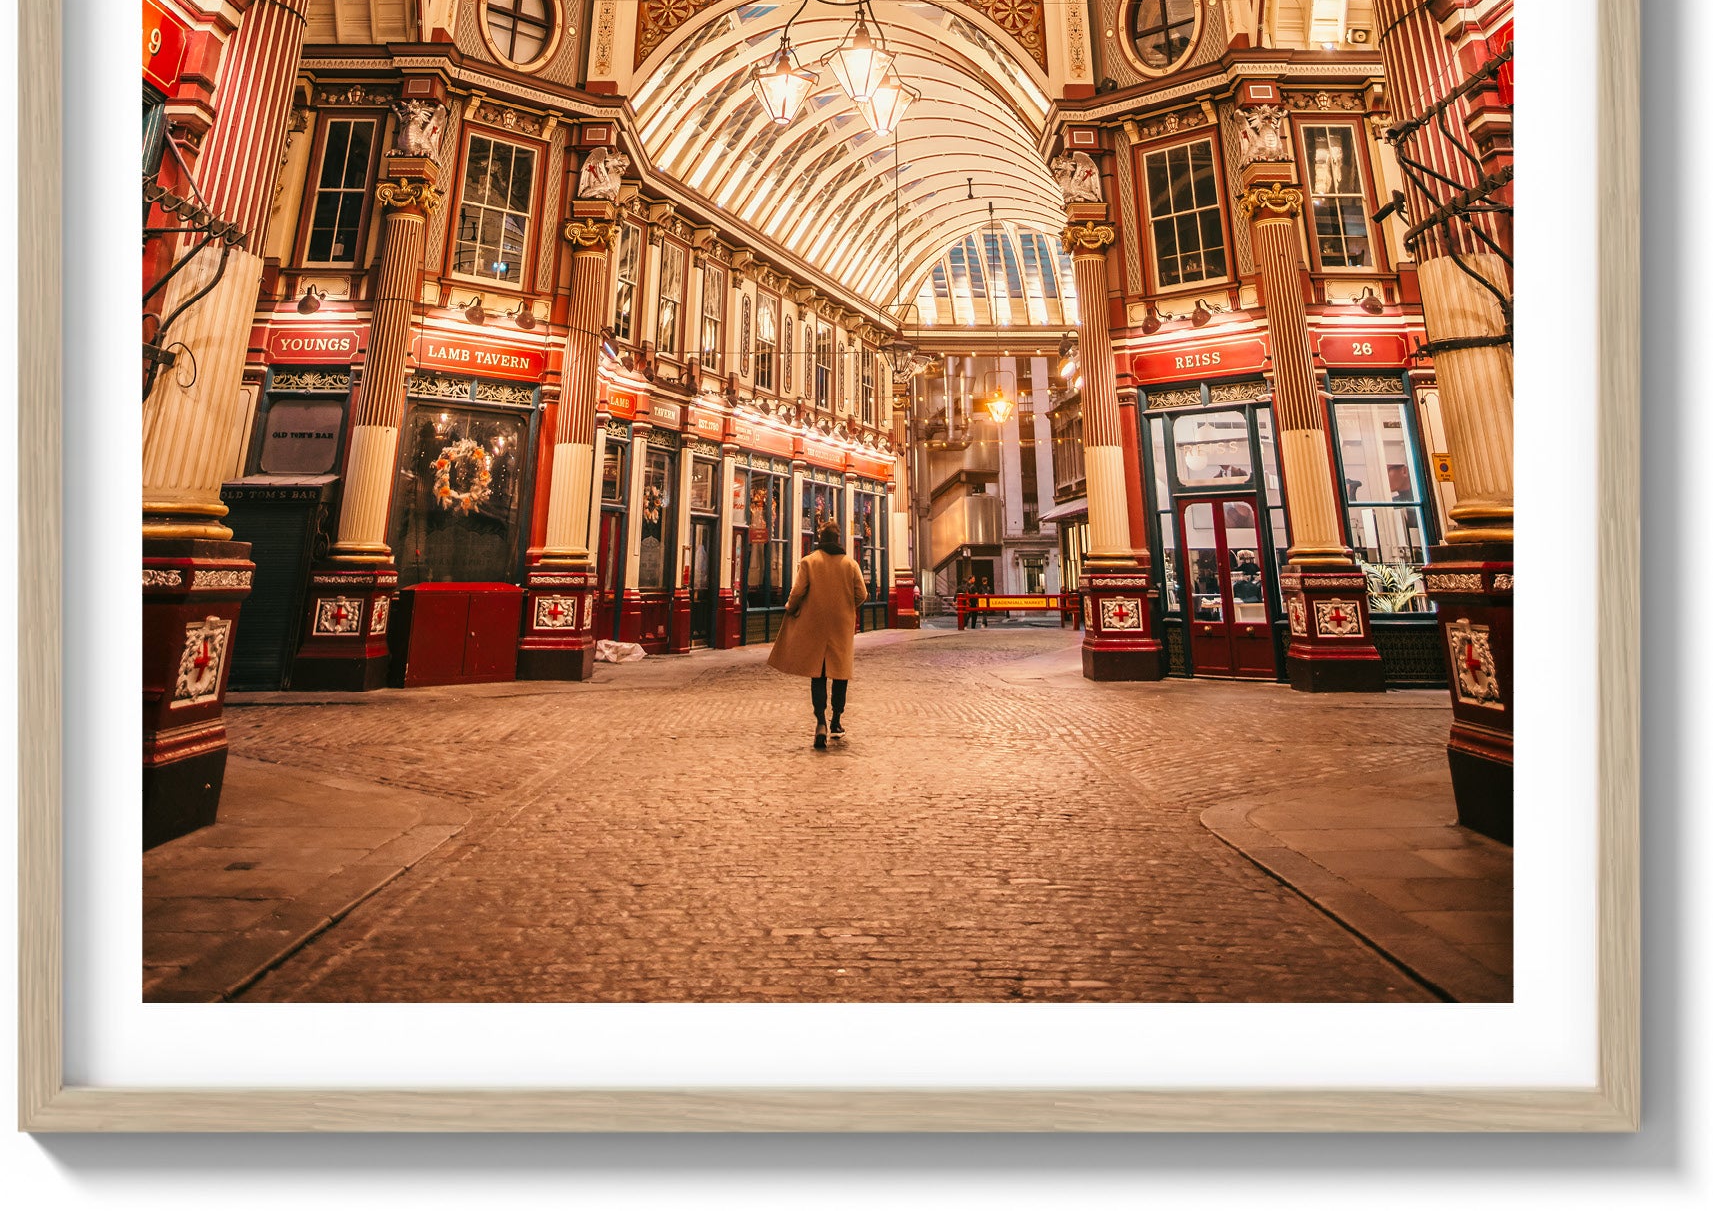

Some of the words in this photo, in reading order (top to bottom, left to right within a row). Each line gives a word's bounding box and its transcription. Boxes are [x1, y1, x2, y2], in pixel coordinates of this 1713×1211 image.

[148, 28, 162, 54] 9
[280, 338, 351, 351] YOUNGS
[1352, 342, 1373, 356] 26
[428, 345, 470, 362] LAMB
[475, 351, 530, 369] TAVERN
[1175, 351, 1221, 369] REISS
[610, 396, 630, 409] LAMB
[654, 406, 676, 420] TAVERN
[290, 431, 313, 439] TOM'S
[315, 432, 334, 440] BAR
[220, 491, 243, 500] OLD
[249, 491, 287, 500] TOM'S
[291, 491, 316, 500] BAR
